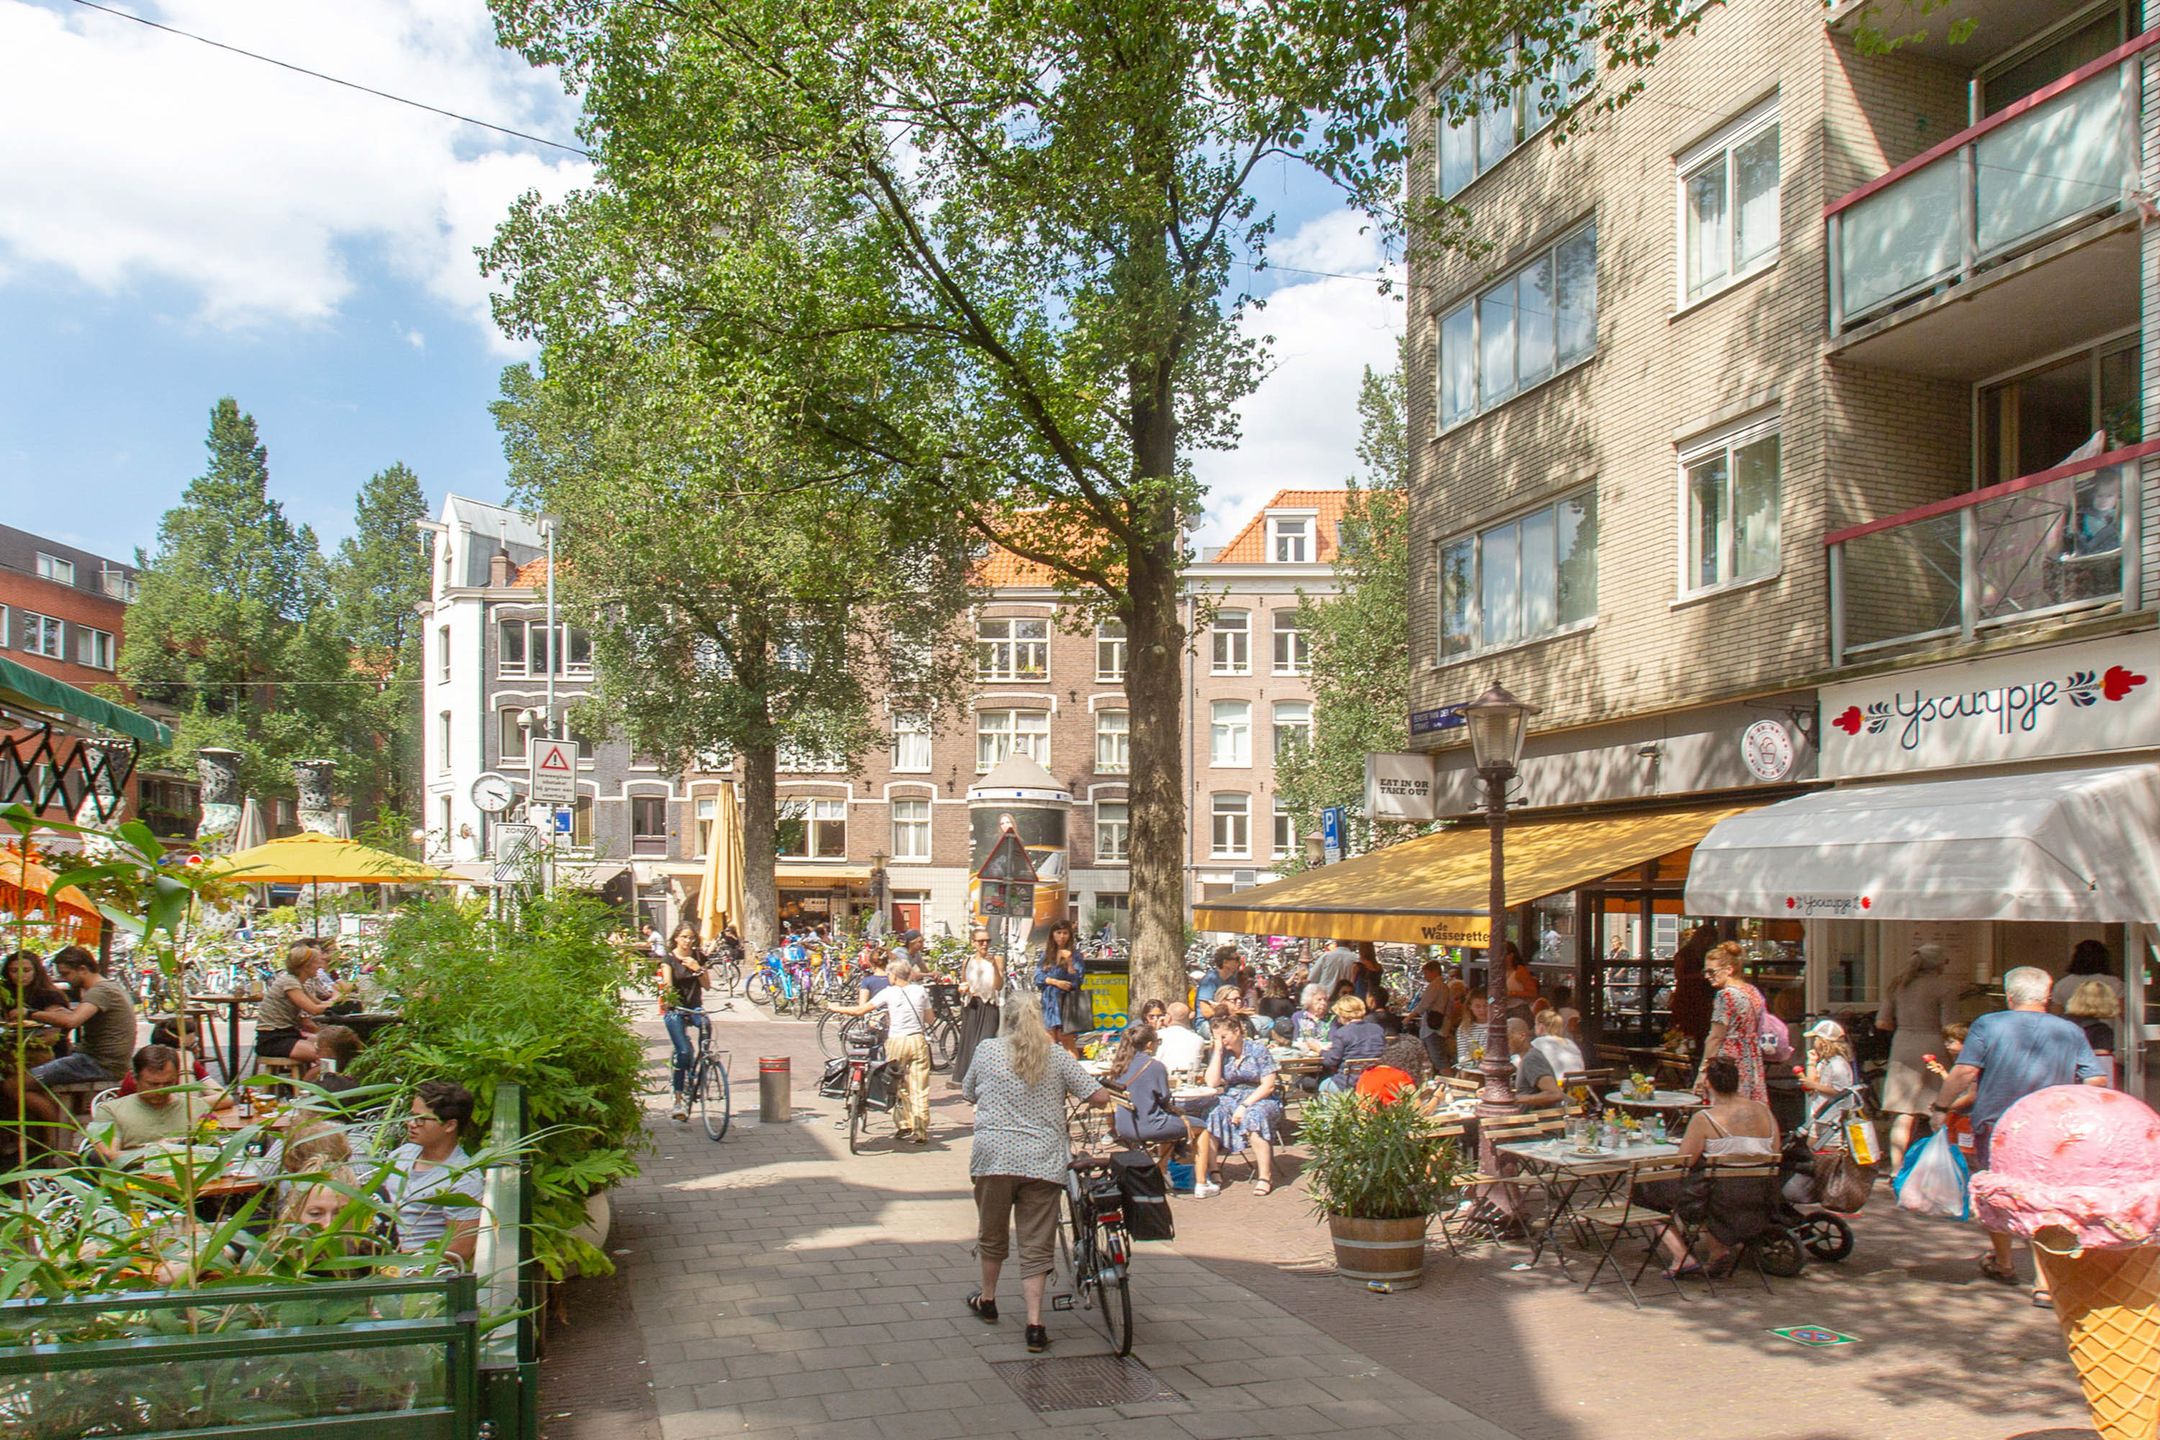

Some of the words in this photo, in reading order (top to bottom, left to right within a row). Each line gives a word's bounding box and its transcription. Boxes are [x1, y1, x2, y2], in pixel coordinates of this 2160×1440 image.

[1380, 779, 1399, 787] EAT
[1414, 780, 1429, 788] OR
[1380, 787, 1406, 795] TAKE
[1408, 788, 1429, 796] OUT
[1325, 812, 1334, 832] P
[1436, 922, 1448, 931] de
[1421, 926, 1490, 942] Wasserette
